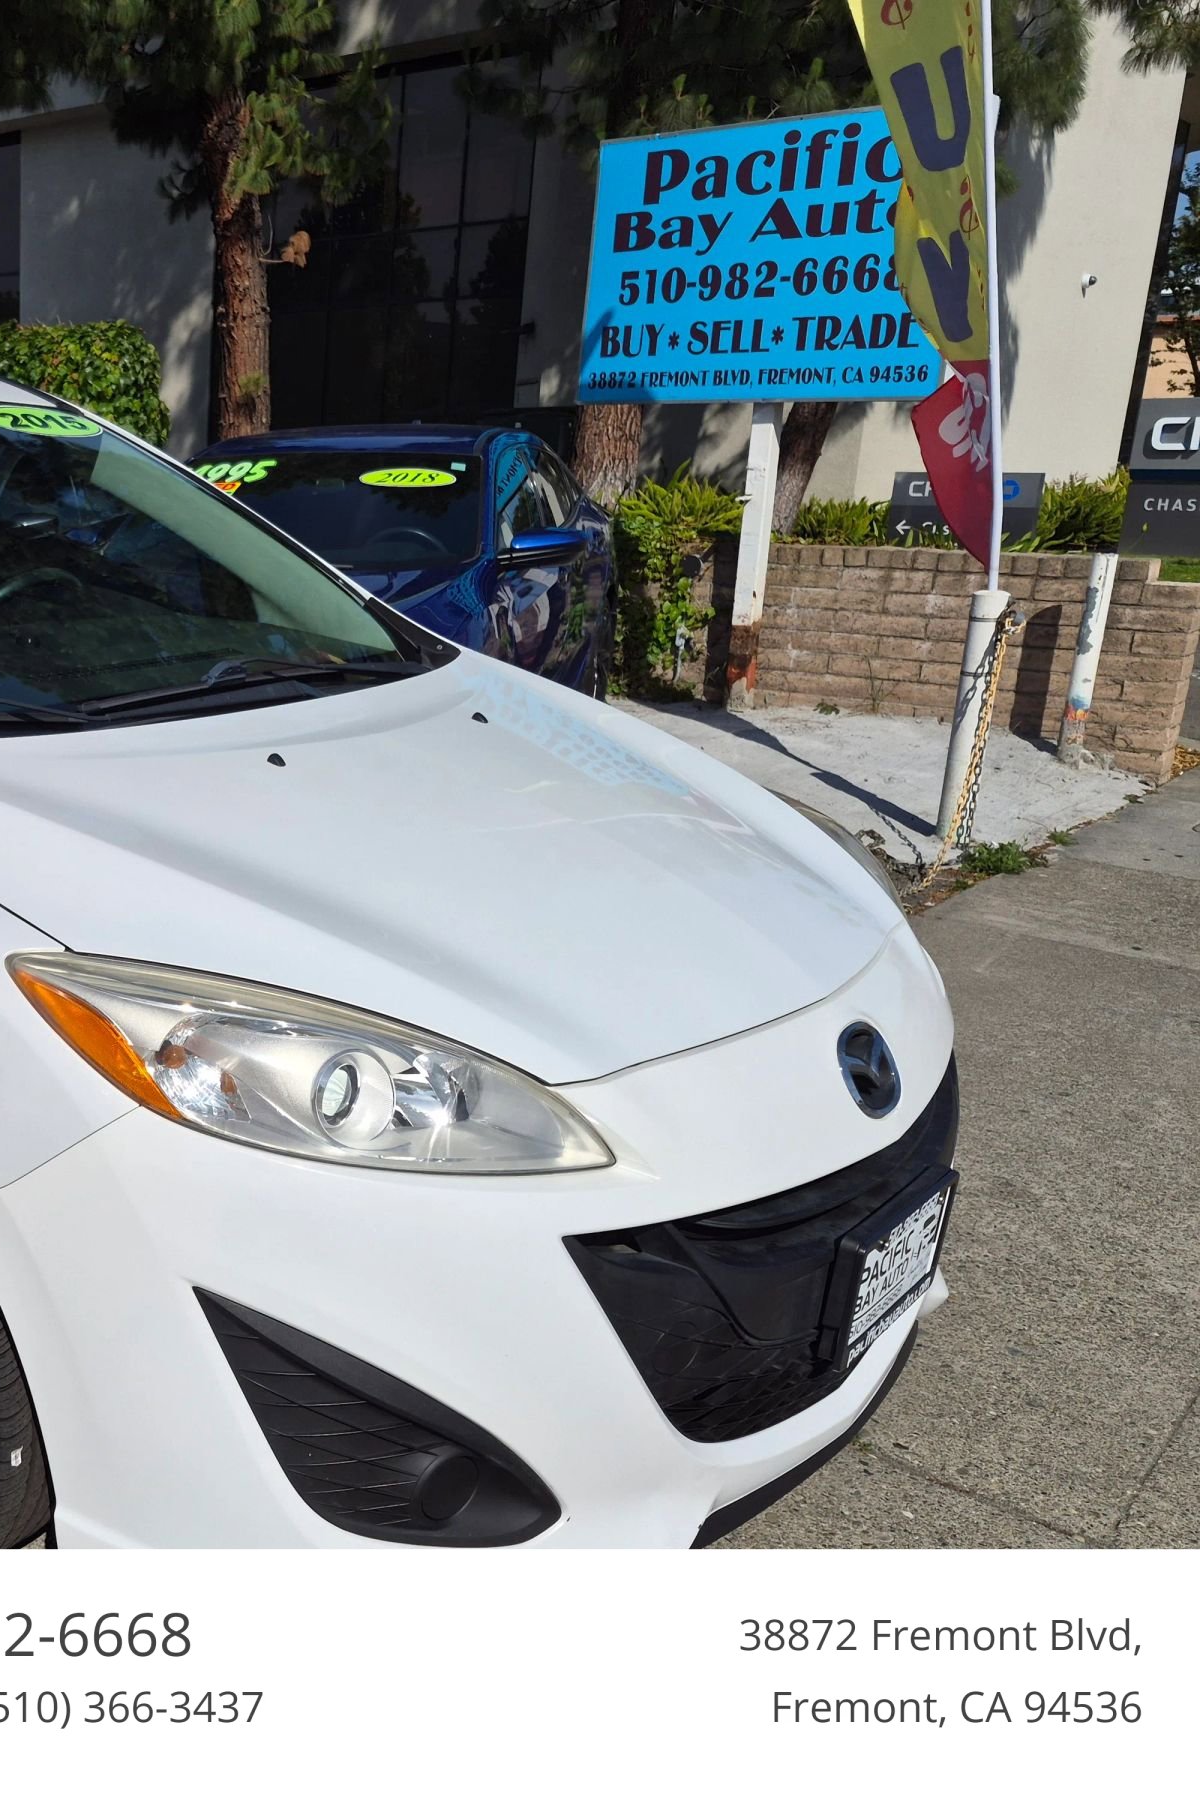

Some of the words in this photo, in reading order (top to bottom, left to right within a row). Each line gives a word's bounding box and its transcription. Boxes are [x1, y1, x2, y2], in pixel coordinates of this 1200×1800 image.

[643, 122, 904, 205] Pacific
[612, 211, 734, 256] Bay
[600, 324, 665, 358] BUY
[687, 319, 770, 355] SELL
[792, 312, 919, 352] TRADE
[588, 371, 637, 390] 38872
[641, 370, 709, 388] FREMONT
[713, 369, 753, 389] BLVD,
[757, 366, 837, 387] FREMONT,
[842, 366, 864, 384] CA
[869, 364, 929, 384] 94536
[377, 471, 440, 484] 2018
[1144, 498, 1200, 512] CHAS
[861, 1229, 915, 1288] PACIFIC
[854, 1282, 879, 1315] BAY
[879, 1257, 909, 1298] AUTO
